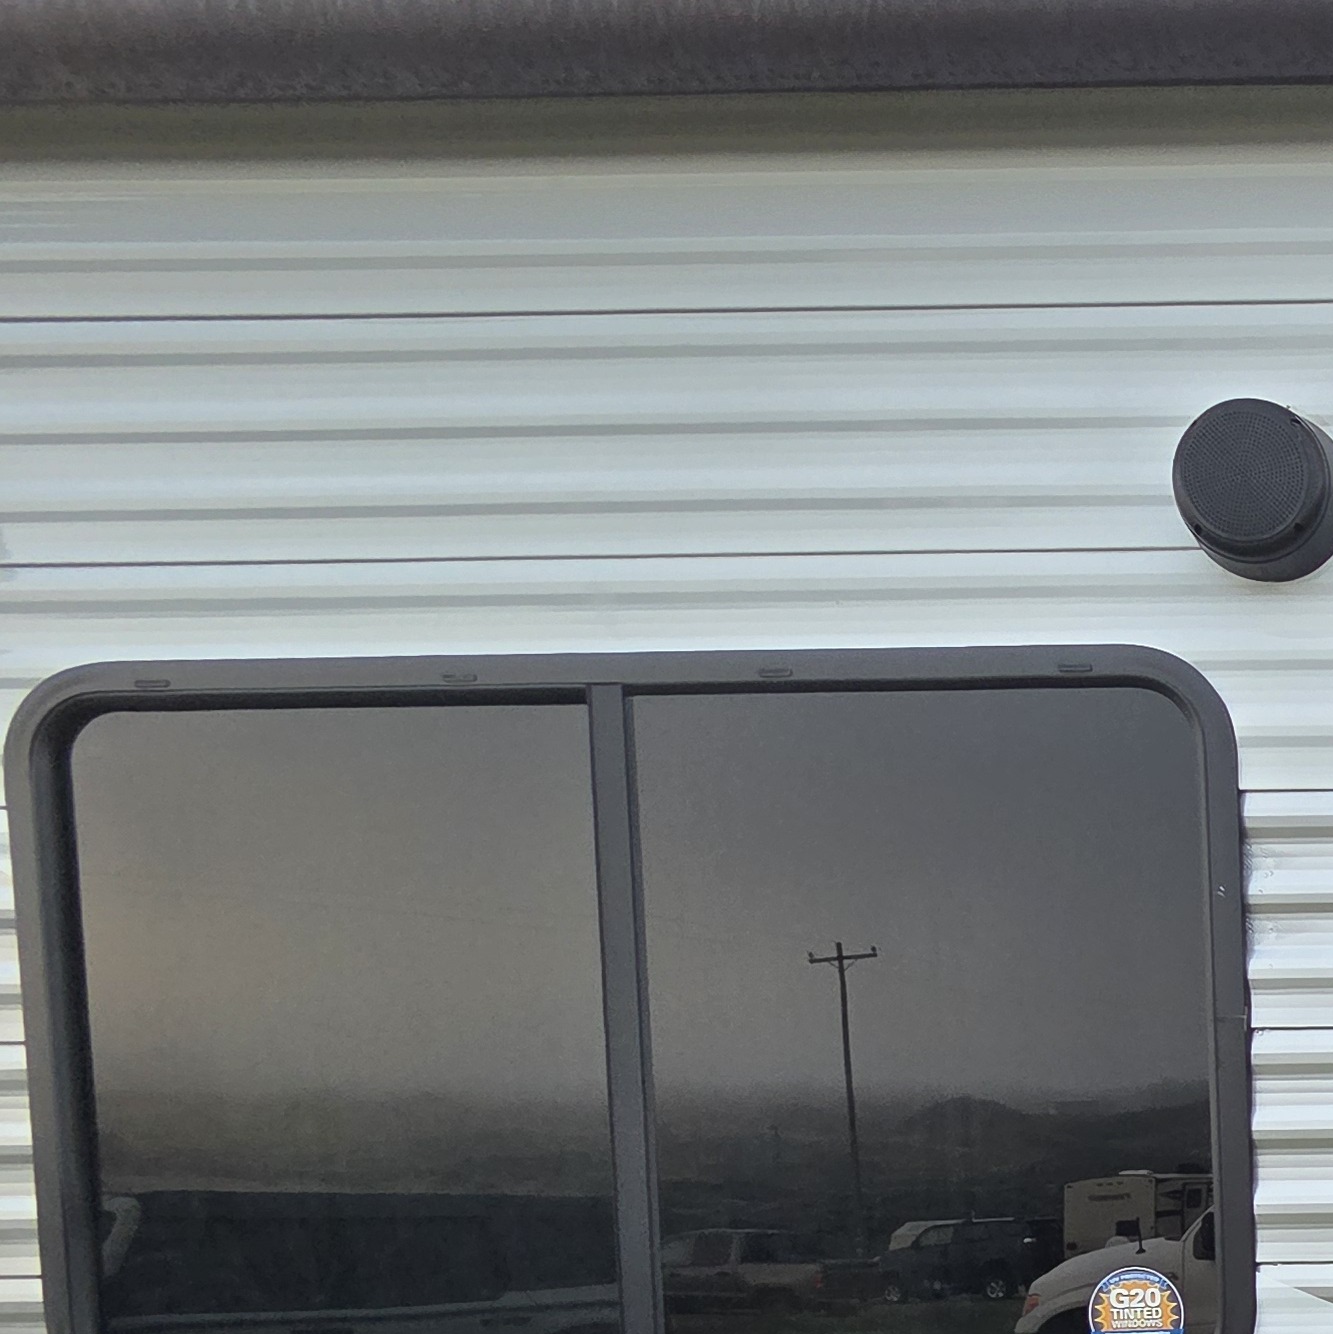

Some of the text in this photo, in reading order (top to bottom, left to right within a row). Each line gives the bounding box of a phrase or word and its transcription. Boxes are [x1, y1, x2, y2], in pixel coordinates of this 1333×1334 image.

[1110, 1288, 1161, 1308] G20
[1110, 1307, 1162, 1320] TINTED
[1111, 1319, 1163, 1329] WINDOWS
